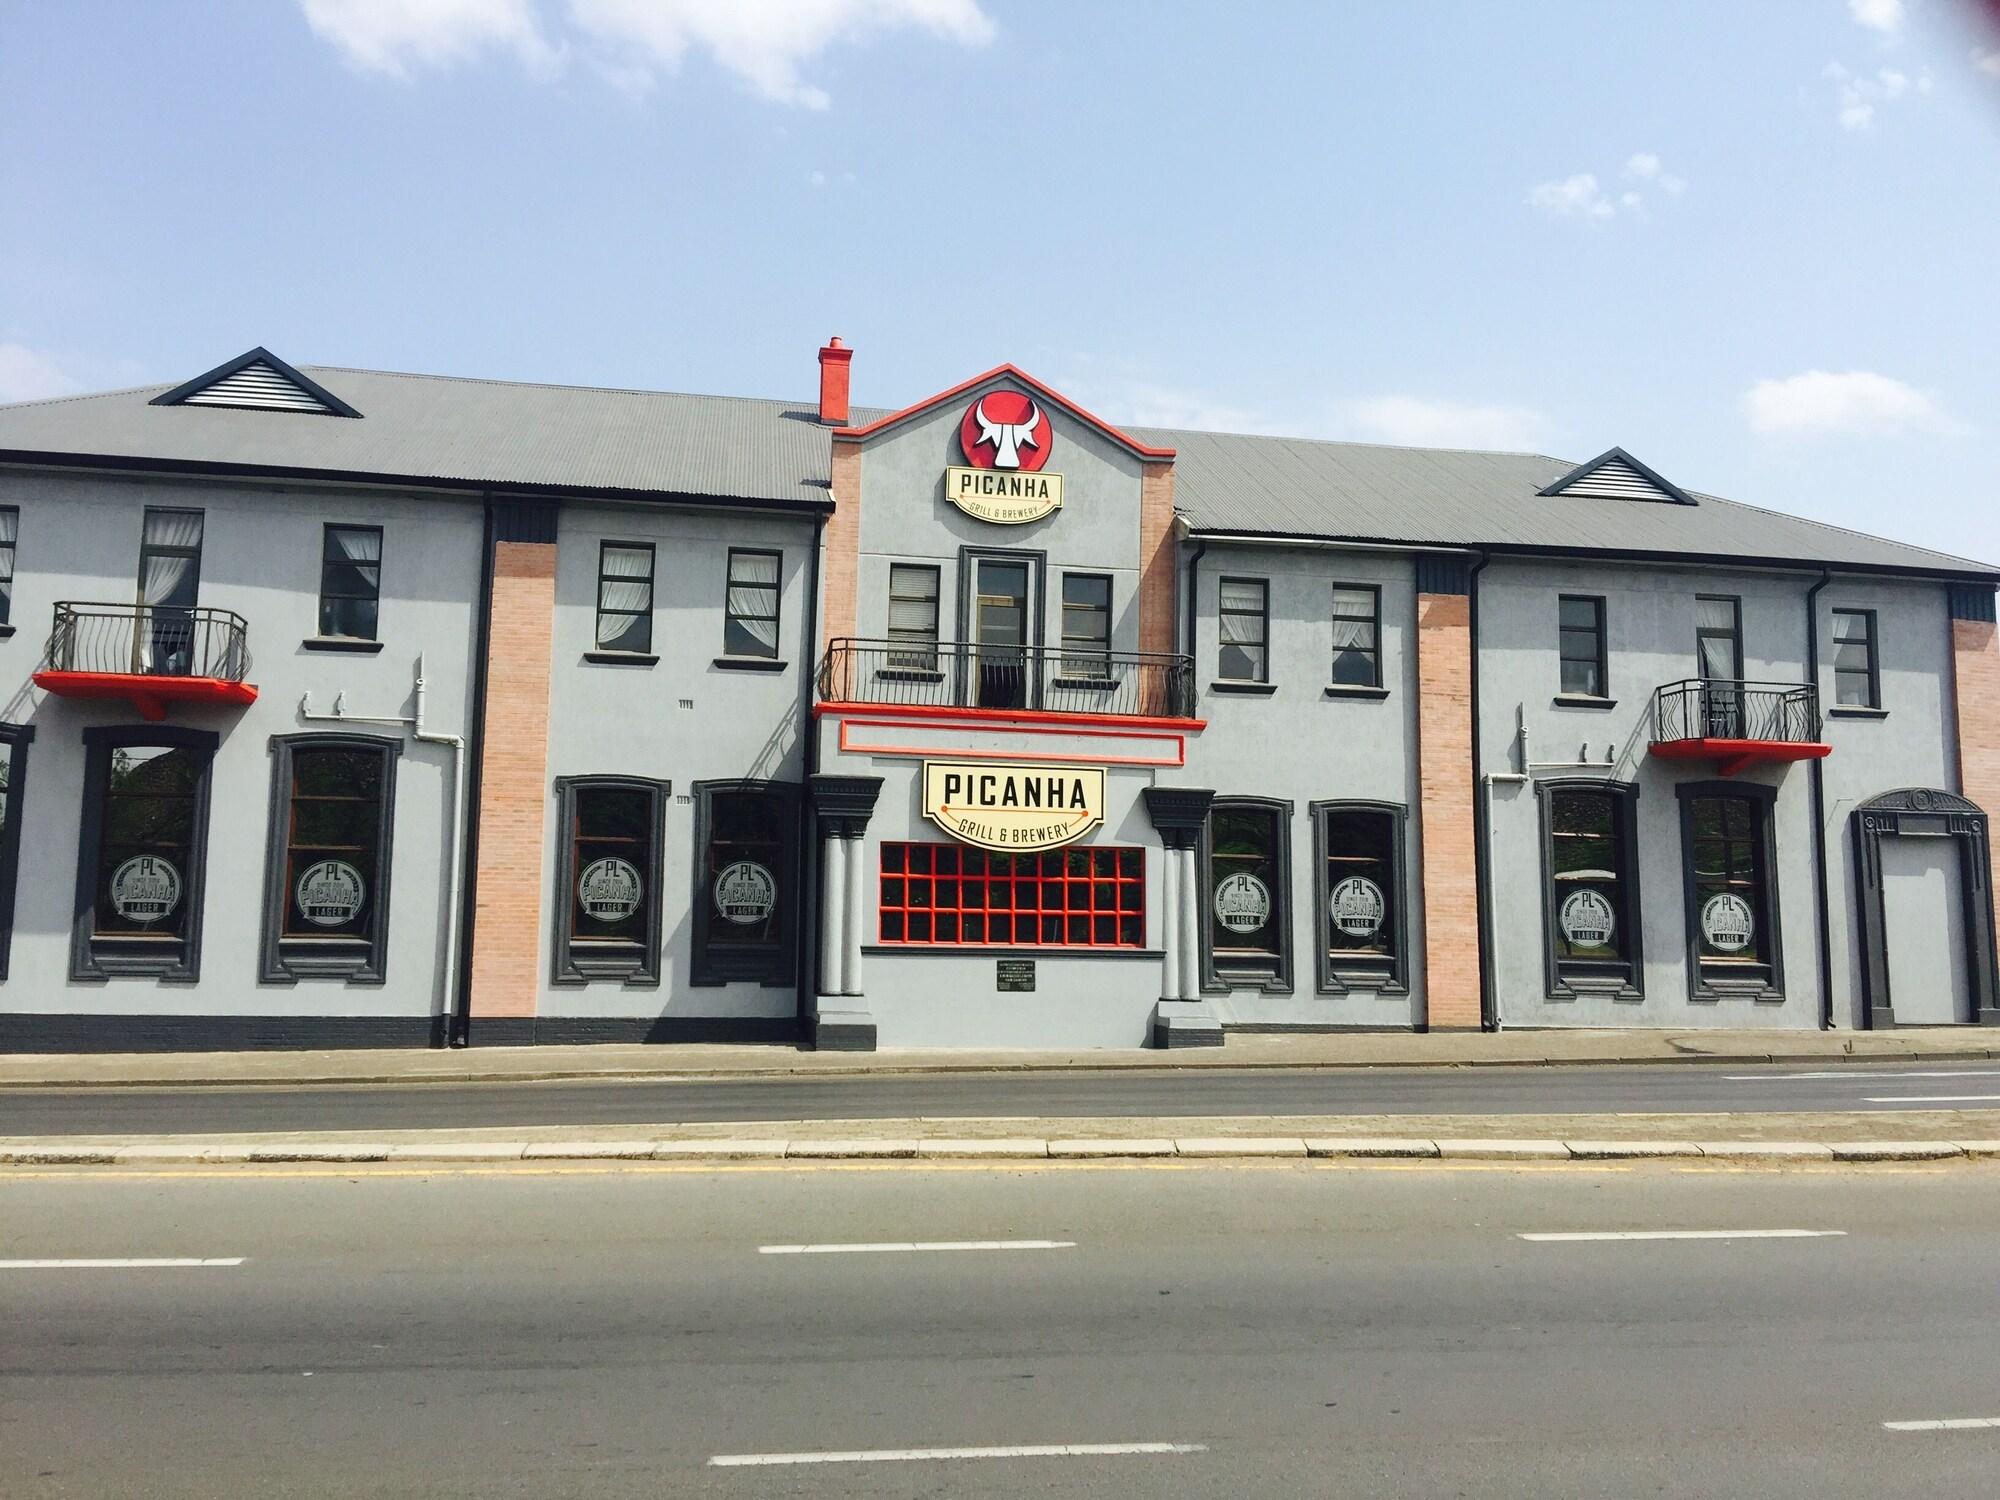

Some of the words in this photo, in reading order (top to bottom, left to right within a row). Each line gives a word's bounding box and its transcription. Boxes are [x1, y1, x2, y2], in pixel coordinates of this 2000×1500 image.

[961, 474, 1049, 498] PICANHA
[969, 502, 991, 516] GRILL
[994, 508, 1000, 518] &
[1002, 506, 1039, 519] BREWERY
[944, 774, 1087, 809] PICANHA
[958, 818, 993, 841] GRILL
[1000, 828, 1007, 842] &
[1012, 821, 1070, 843] BREWERY
[141, 858, 157, 876] PL
[326, 863, 341, 880] PL
[605, 861, 620, 877] PL
[740, 865, 754, 881] PL
[1238, 876, 1250, 892] PL
[1352, 880, 1365, 895] PL
[116, 883, 176, 902] PICANHA
[302, 887, 359, 906] PICANHA
[583, 885, 637, 902] PICANHA
[718, 888, 772, 905] PICANHA
[1582, 892, 1595, 908] PL
[130, 903, 159, 912] LAGER
[597, 903, 623, 912] LAGER
[732, 906, 758, 915] LAGER
[1219, 898, 1266, 916] PICANHA
[1335, 902, 1381, 918] PICANHA
[1722, 896, 1735, 911] PL
[316, 907, 343, 917] LAGER
[1232, 916, 1255, 924] LAGER
[1347, 919, 1370, 928] LAGER
[1564, 914, 1610, 930] PICANHA
[1705, 917, 1749, 934] PICANHA
[1577, 931, 1599, 940] LAGER
[1719, 934, 1739, 943] LAGER
